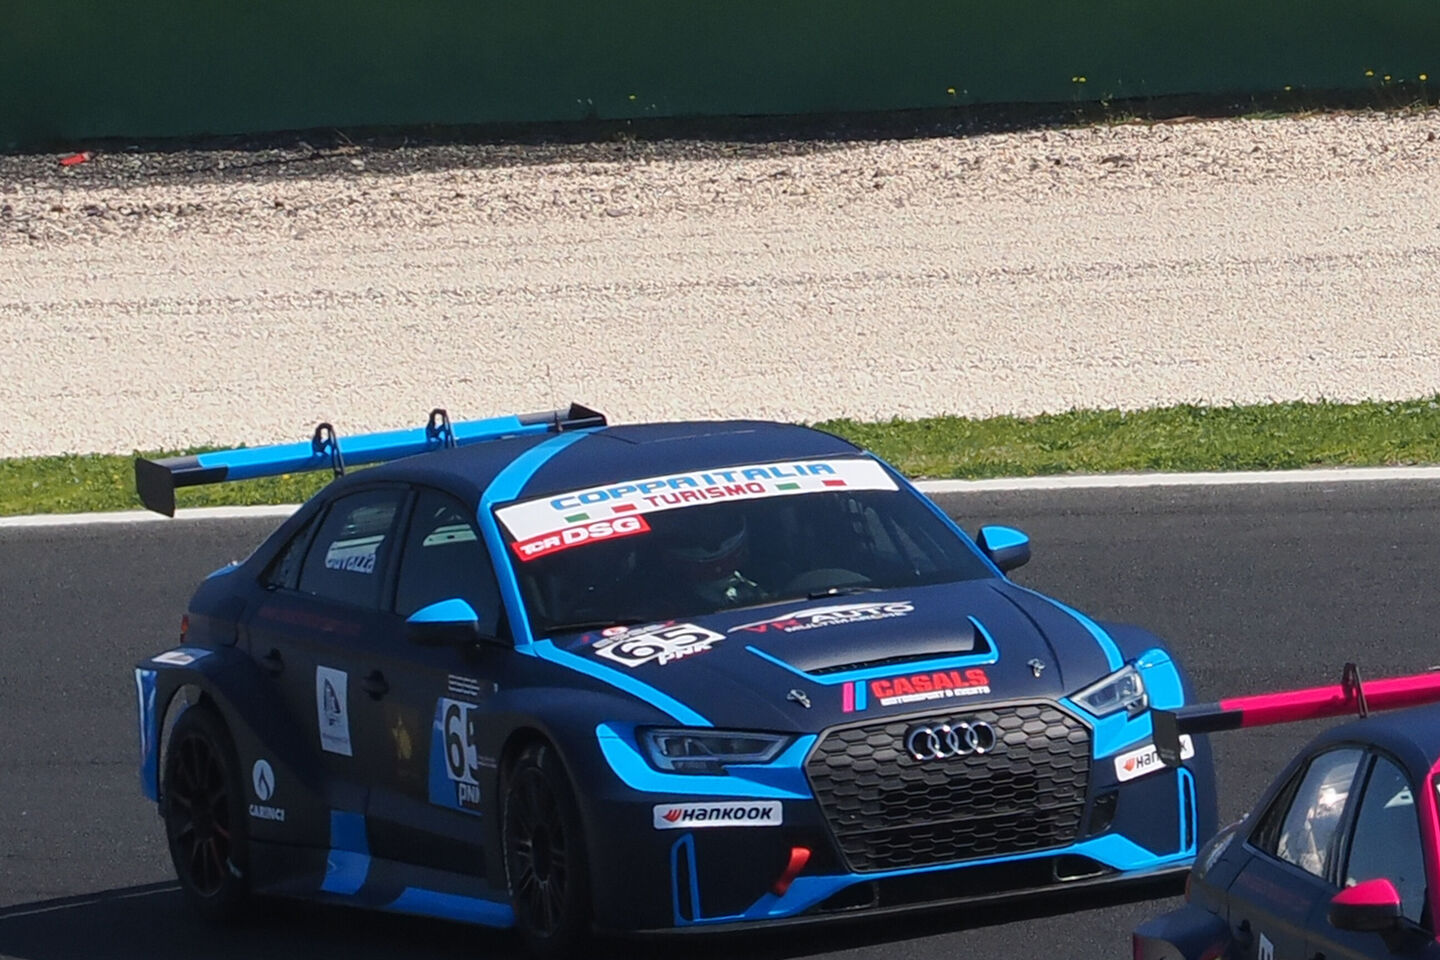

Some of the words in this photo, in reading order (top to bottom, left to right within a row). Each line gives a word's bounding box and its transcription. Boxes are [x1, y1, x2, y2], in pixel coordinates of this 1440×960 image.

[643, 482, 766, 508] TURISMO
[520, 535, 561, 556] TCR
[564, 516, 643, 545] DSG
[812, 604, 915, 624] AUTO
[610, 626, 711, 661] 65
[871, 668, 989, 699] CASALS
